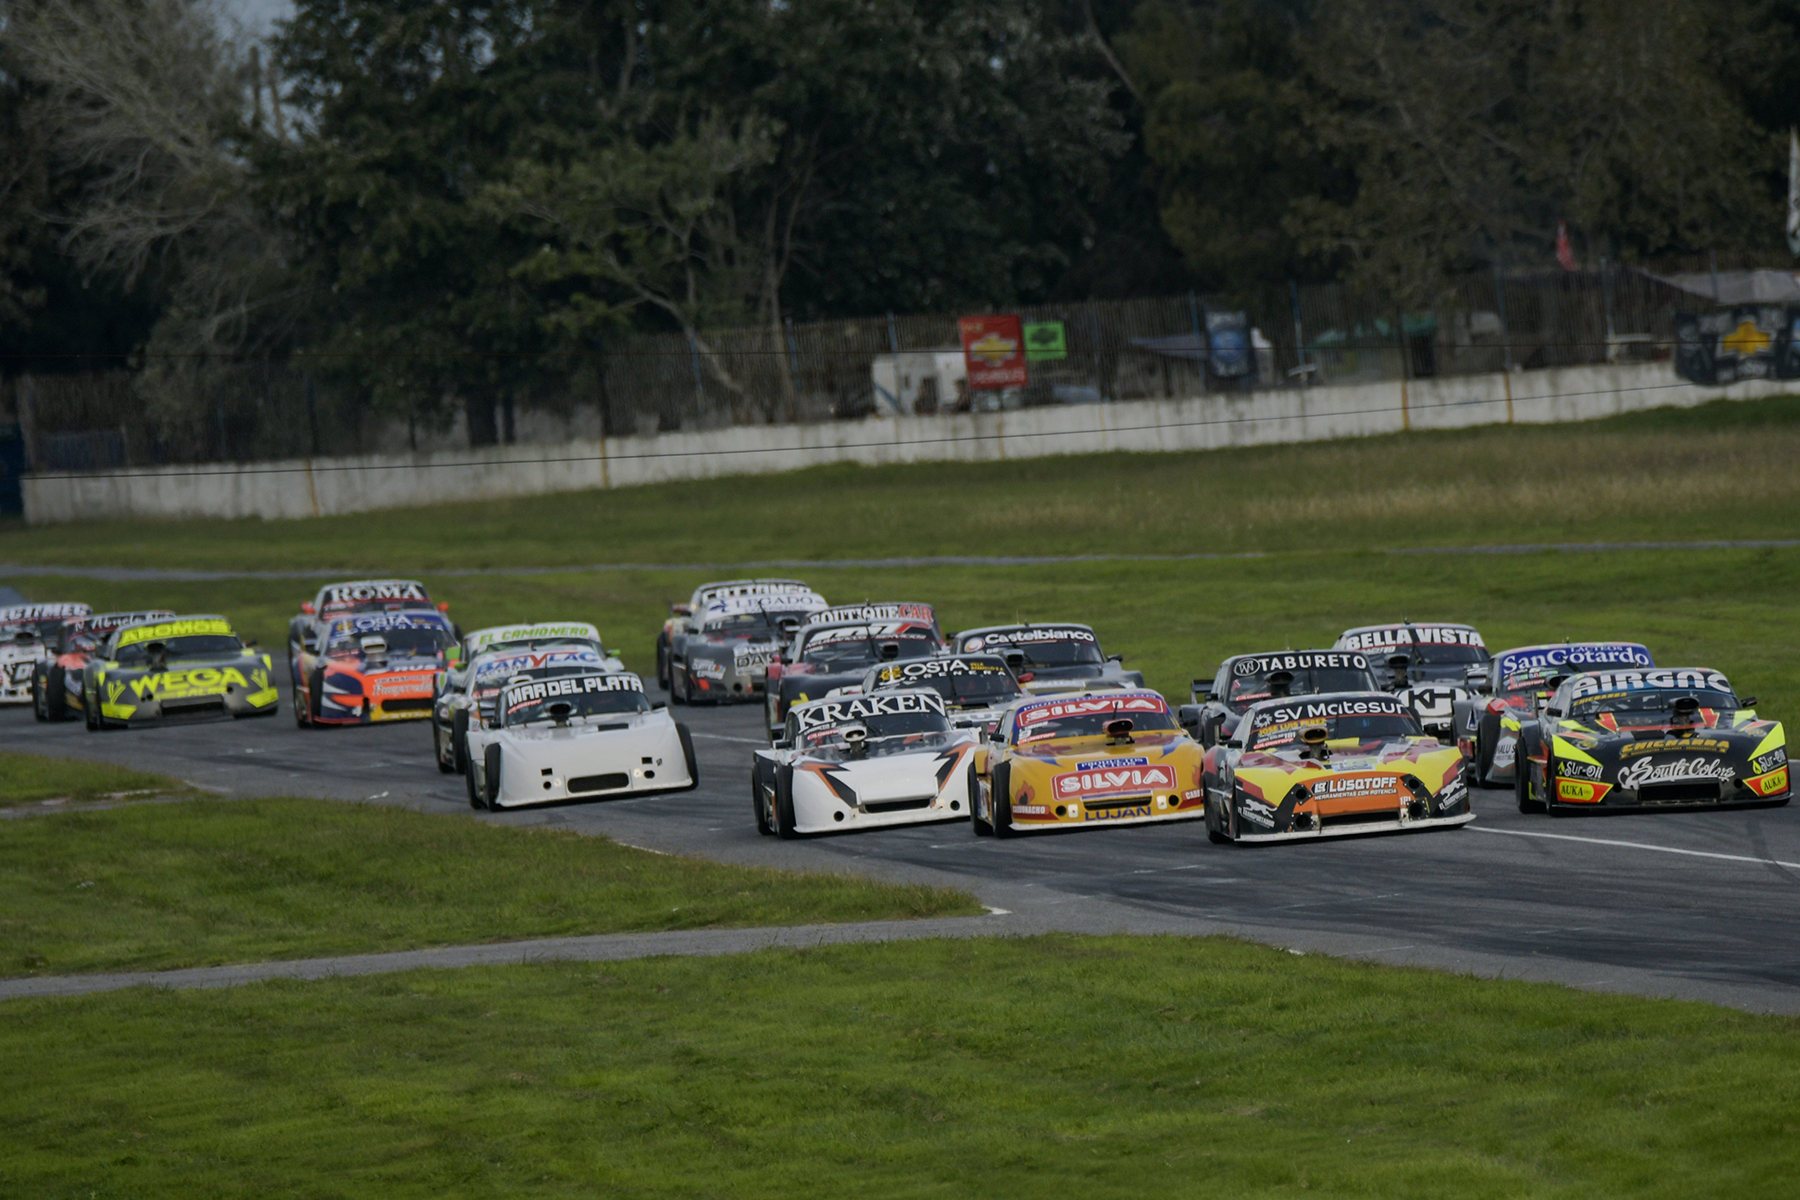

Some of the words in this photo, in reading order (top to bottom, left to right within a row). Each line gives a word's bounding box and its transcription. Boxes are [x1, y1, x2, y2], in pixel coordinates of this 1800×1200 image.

[331, 584, 424, 601] ROMA
[120, 619, 230, 646] AROMOS
[479, 633, 496, 645] EL
[501, 626, 589, 641] CAMIONERO
[985, 629, 1095, 644] Castelblanco
[1345, 628, 1413, 650] BELLA
[1415, 627, 1485, 647] VISTA
[1258, 654, 1367, 671] TABURETO
[130, 667, 249, 697] WEGA
[507, 682, 548, 707] MAR
[547, 679, 583, 697] DEL
[583, 676, 644, 694] PLATA
[797, 694, 947, 733] KRAKEN
[1026, 699, 1157, 721] SILVIA
[1274, 705, 1303, 723] SV
[1307, 700, 1403, 718] Matesur
[1060, 769, 1169, 793] SILVIA
[1617, 756, 1690, 790] South
[1688, 757, 1736, 782] Colors
[1764, 777, 1782, 791] AUKA
[1314, 791, 1357, 801] HERRAMIENTAS
[1370, 788, 1397, 796] POTENCIA
[1561, 785, 1583, 796] AUKA
[1084, 806, 1152, 821] LUJAN
